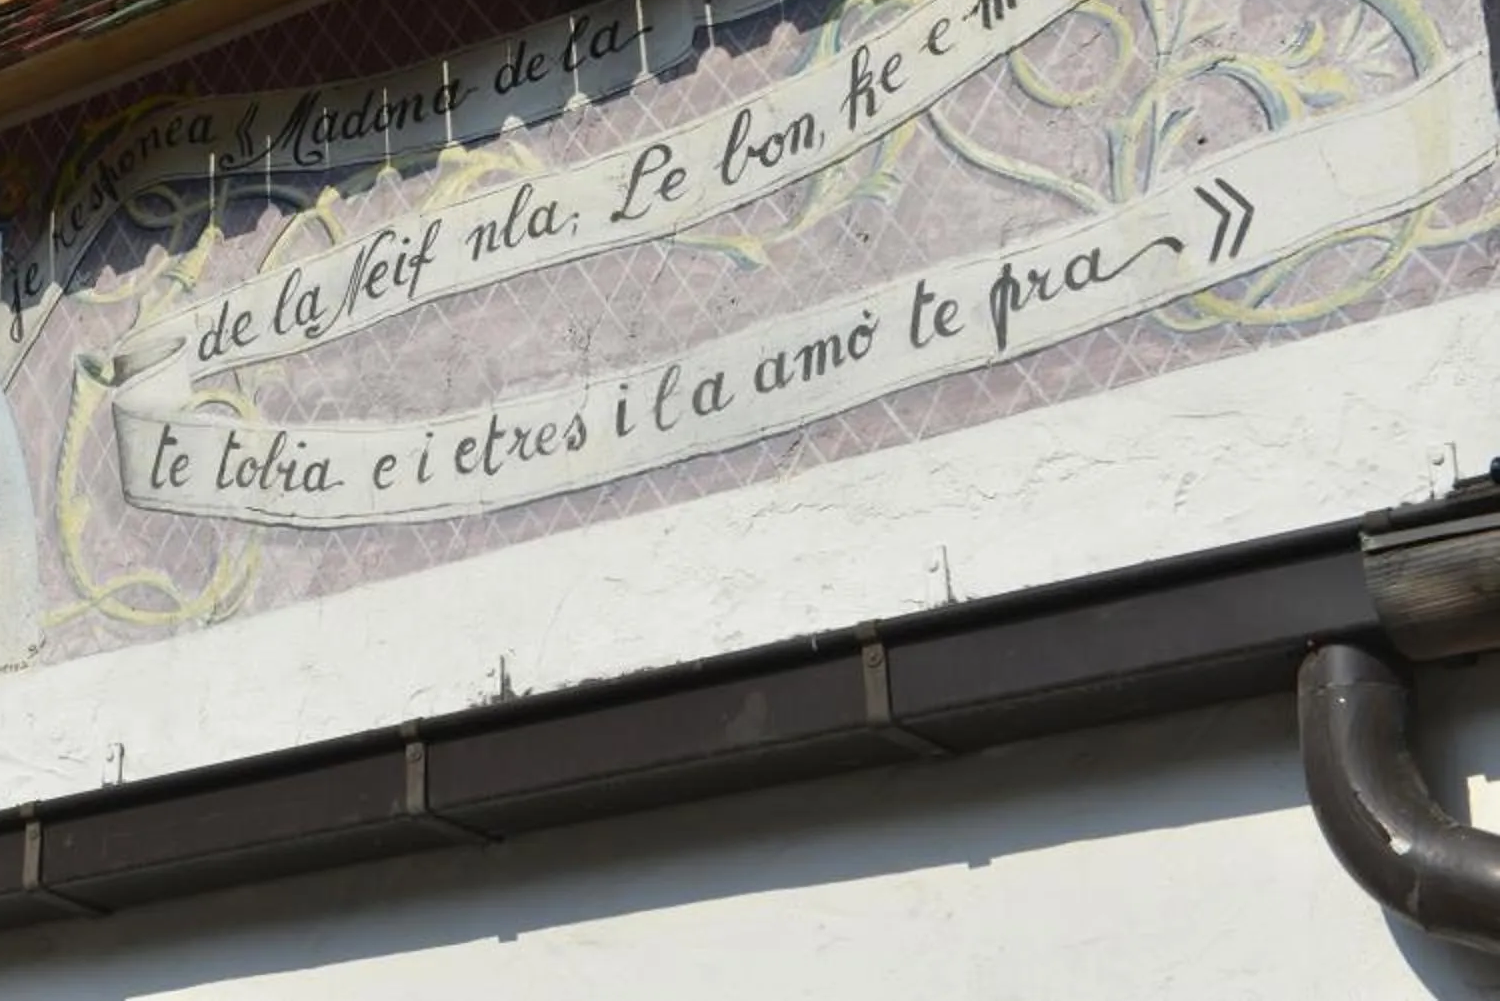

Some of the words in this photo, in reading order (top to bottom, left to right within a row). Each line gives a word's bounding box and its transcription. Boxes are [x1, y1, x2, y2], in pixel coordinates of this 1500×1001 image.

[495, 40, 551, 95] de
[563, 15, 652, 73] la
[199, 299, 257, 361] de
[273, 268, 325, 333] la
[305, 218, 441, 339] Neif
[150, 423, 190, 490] te
[373, 454, 401, 490] e
[909, 278, 967, 349] te
